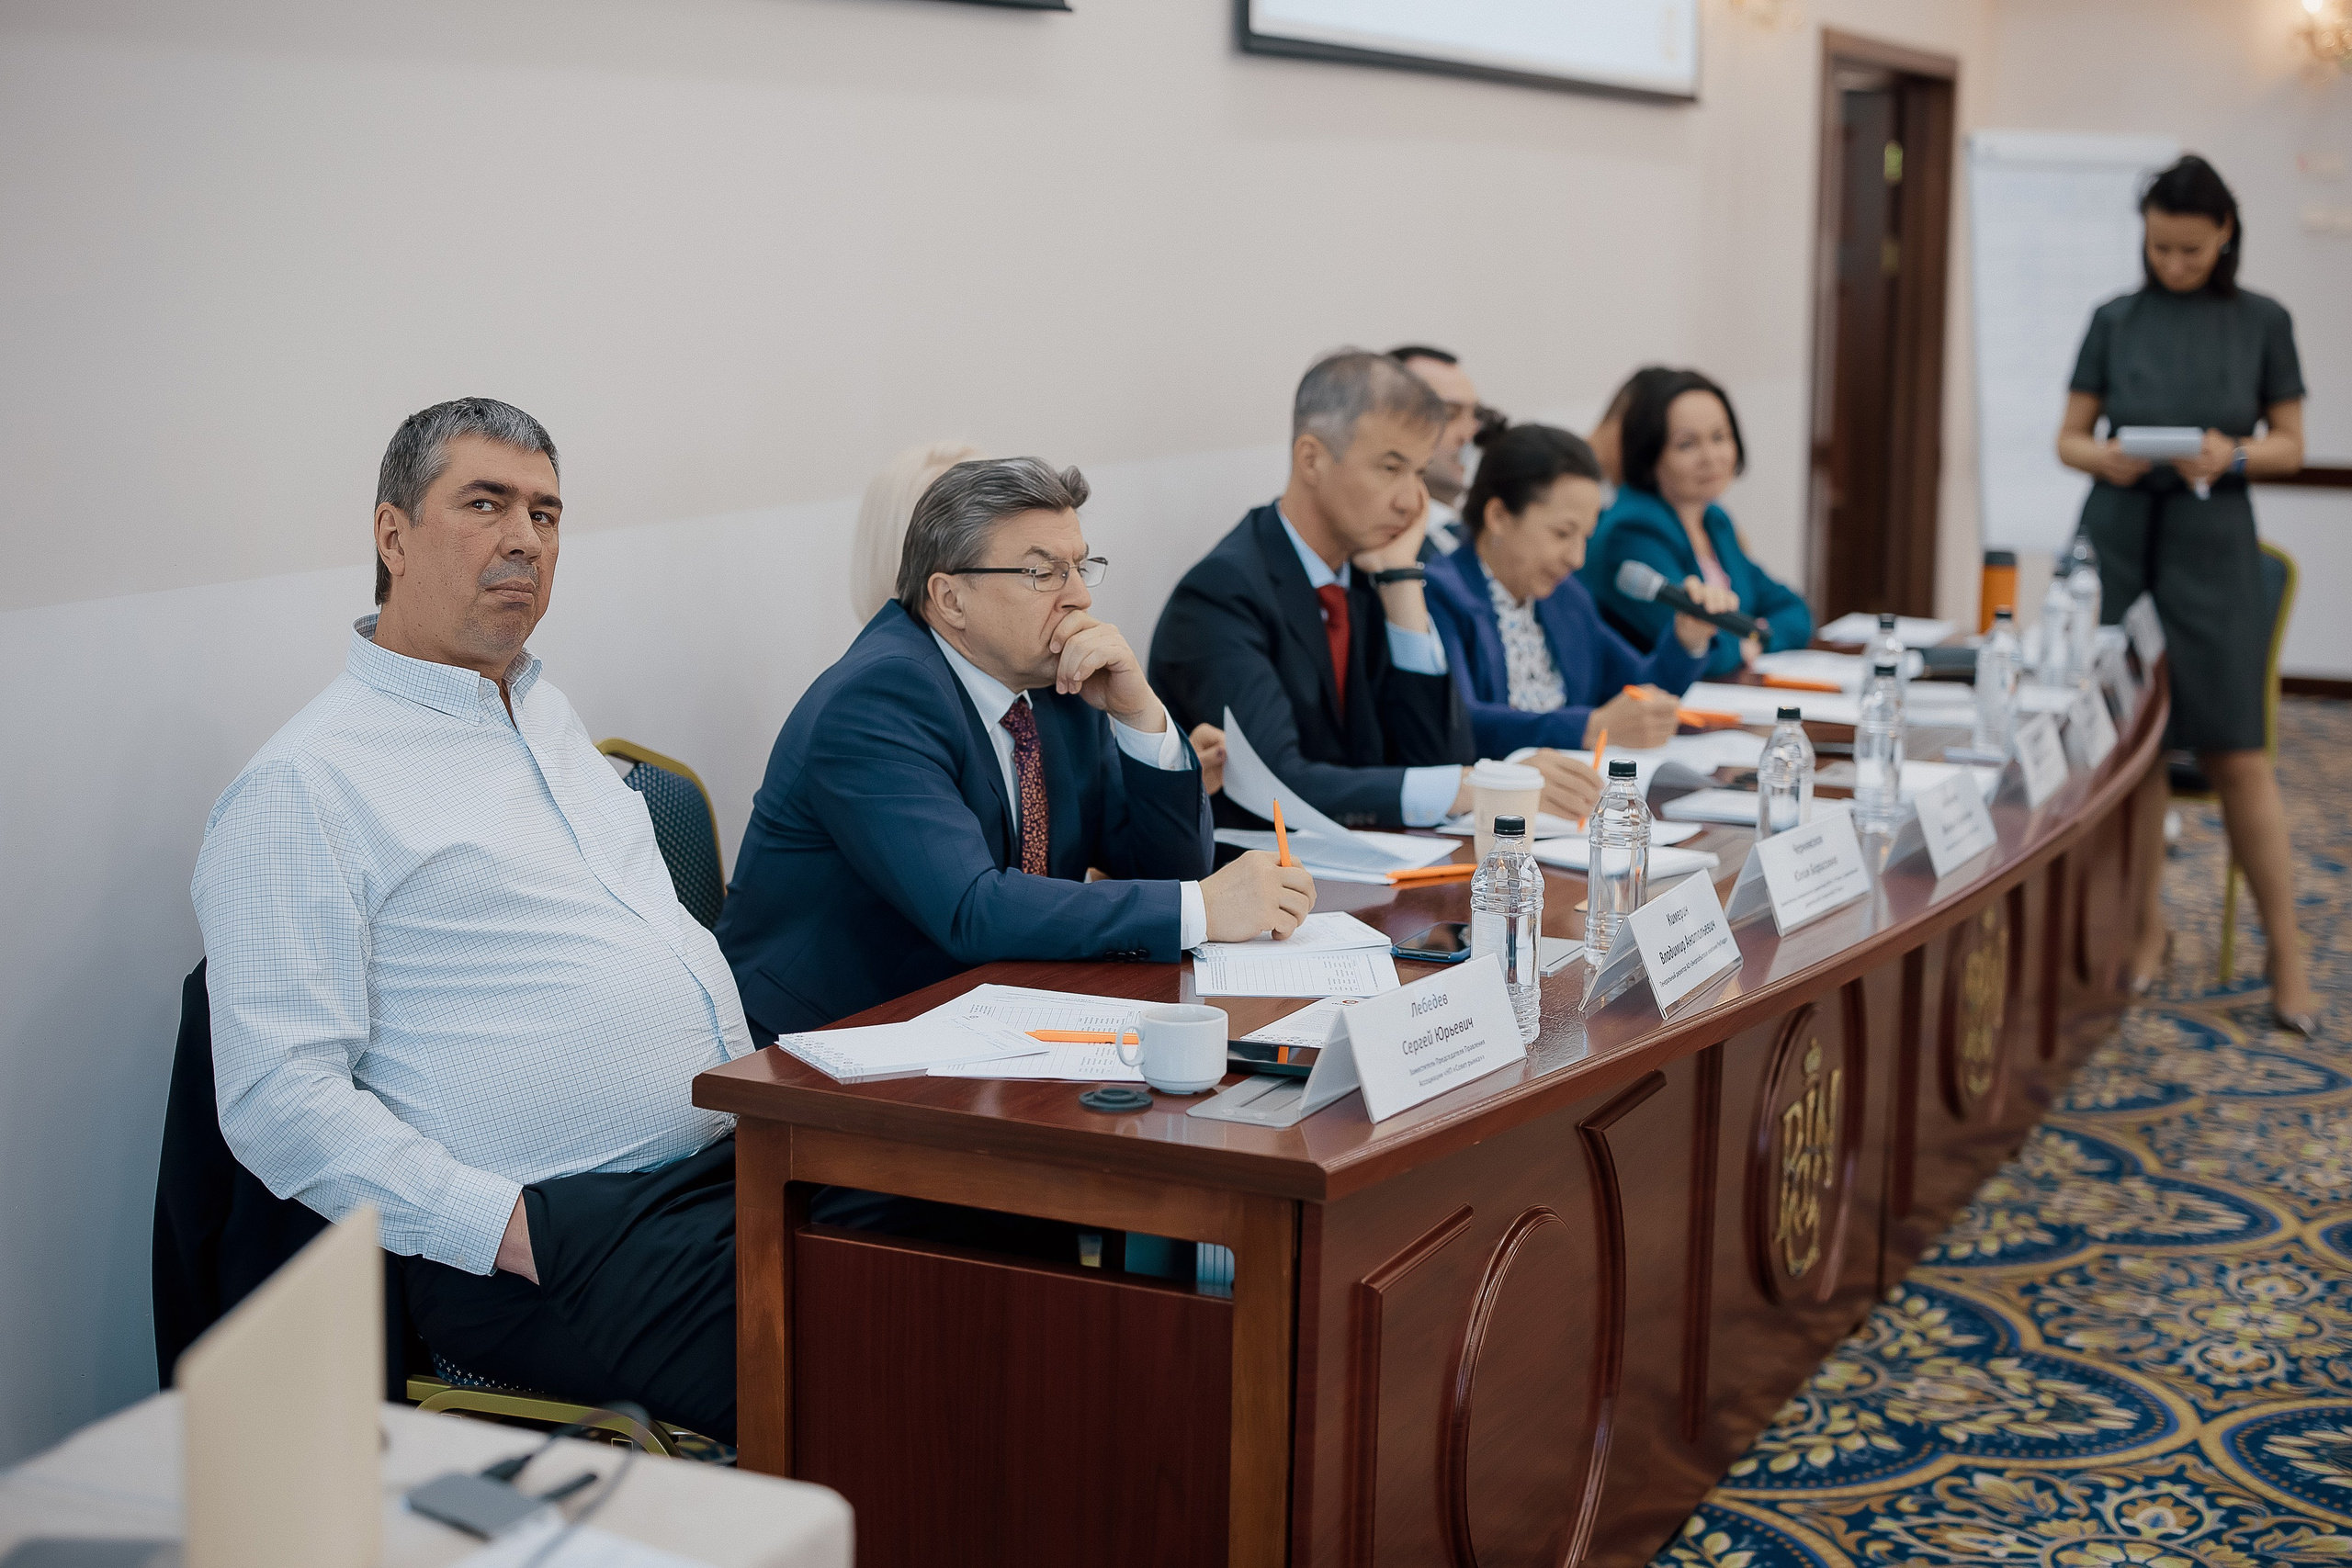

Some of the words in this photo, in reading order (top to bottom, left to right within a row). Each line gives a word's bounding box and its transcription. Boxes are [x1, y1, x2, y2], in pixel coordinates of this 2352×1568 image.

[1658, 941, 1687, 965] Владимир
[1410, 993, 1449, 1018] Лебедев
[1402, 1031, 1433, 1055] Сергей
[1435, 1017, 1474, 1043] Юрьевич
